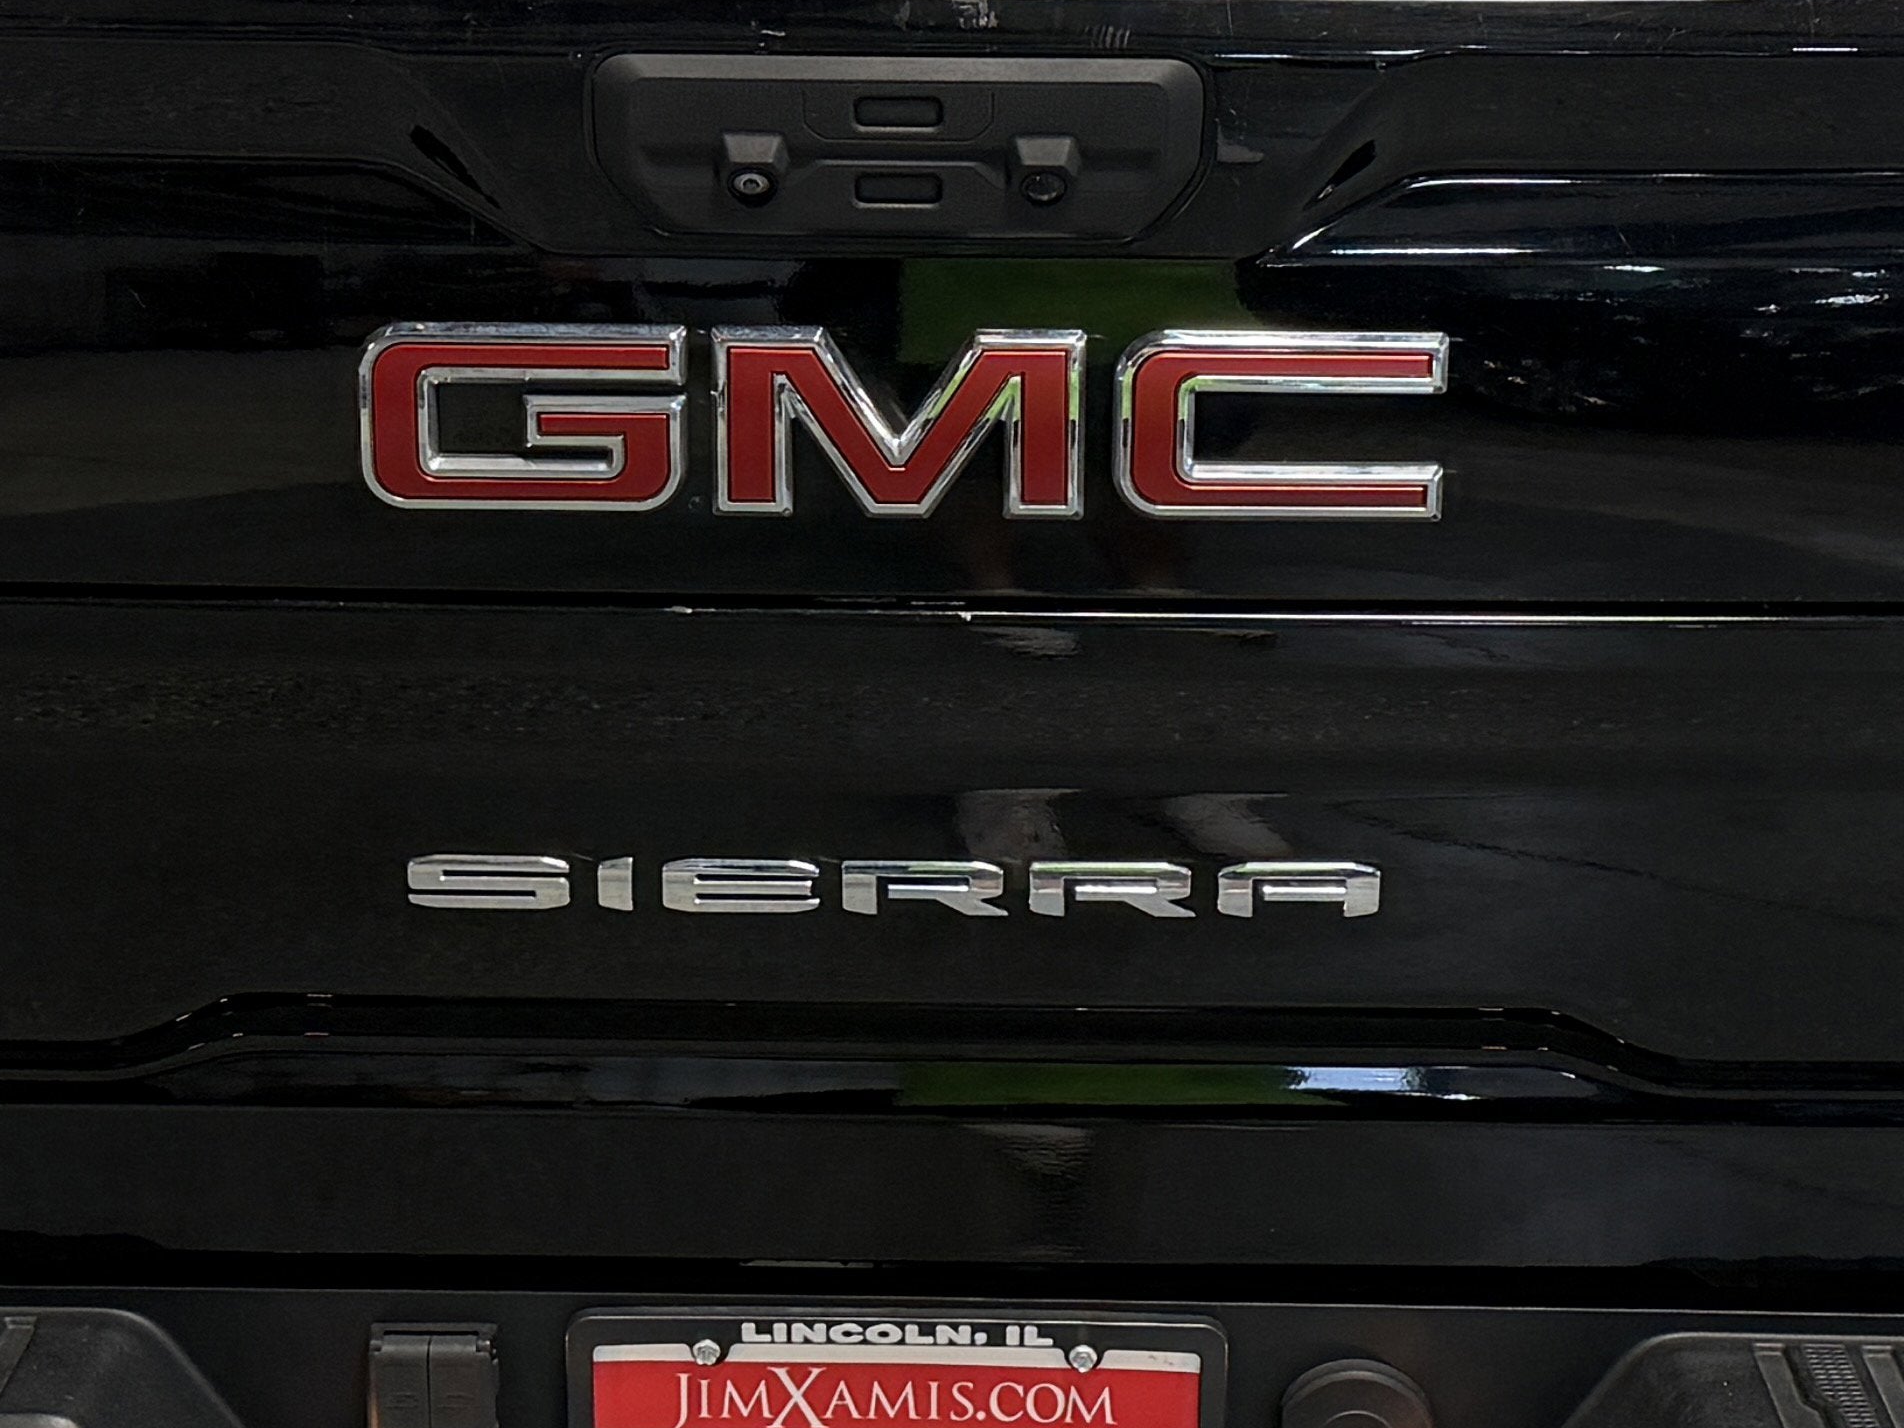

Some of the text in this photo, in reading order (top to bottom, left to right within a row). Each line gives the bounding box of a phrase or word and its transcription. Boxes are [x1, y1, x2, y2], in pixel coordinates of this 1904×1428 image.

[358, 322, 1450, 521] GMC
[407, 854, 1381, 918] SIERRA
[741, 1322, 1055, 1347] LINCOLN, IL
